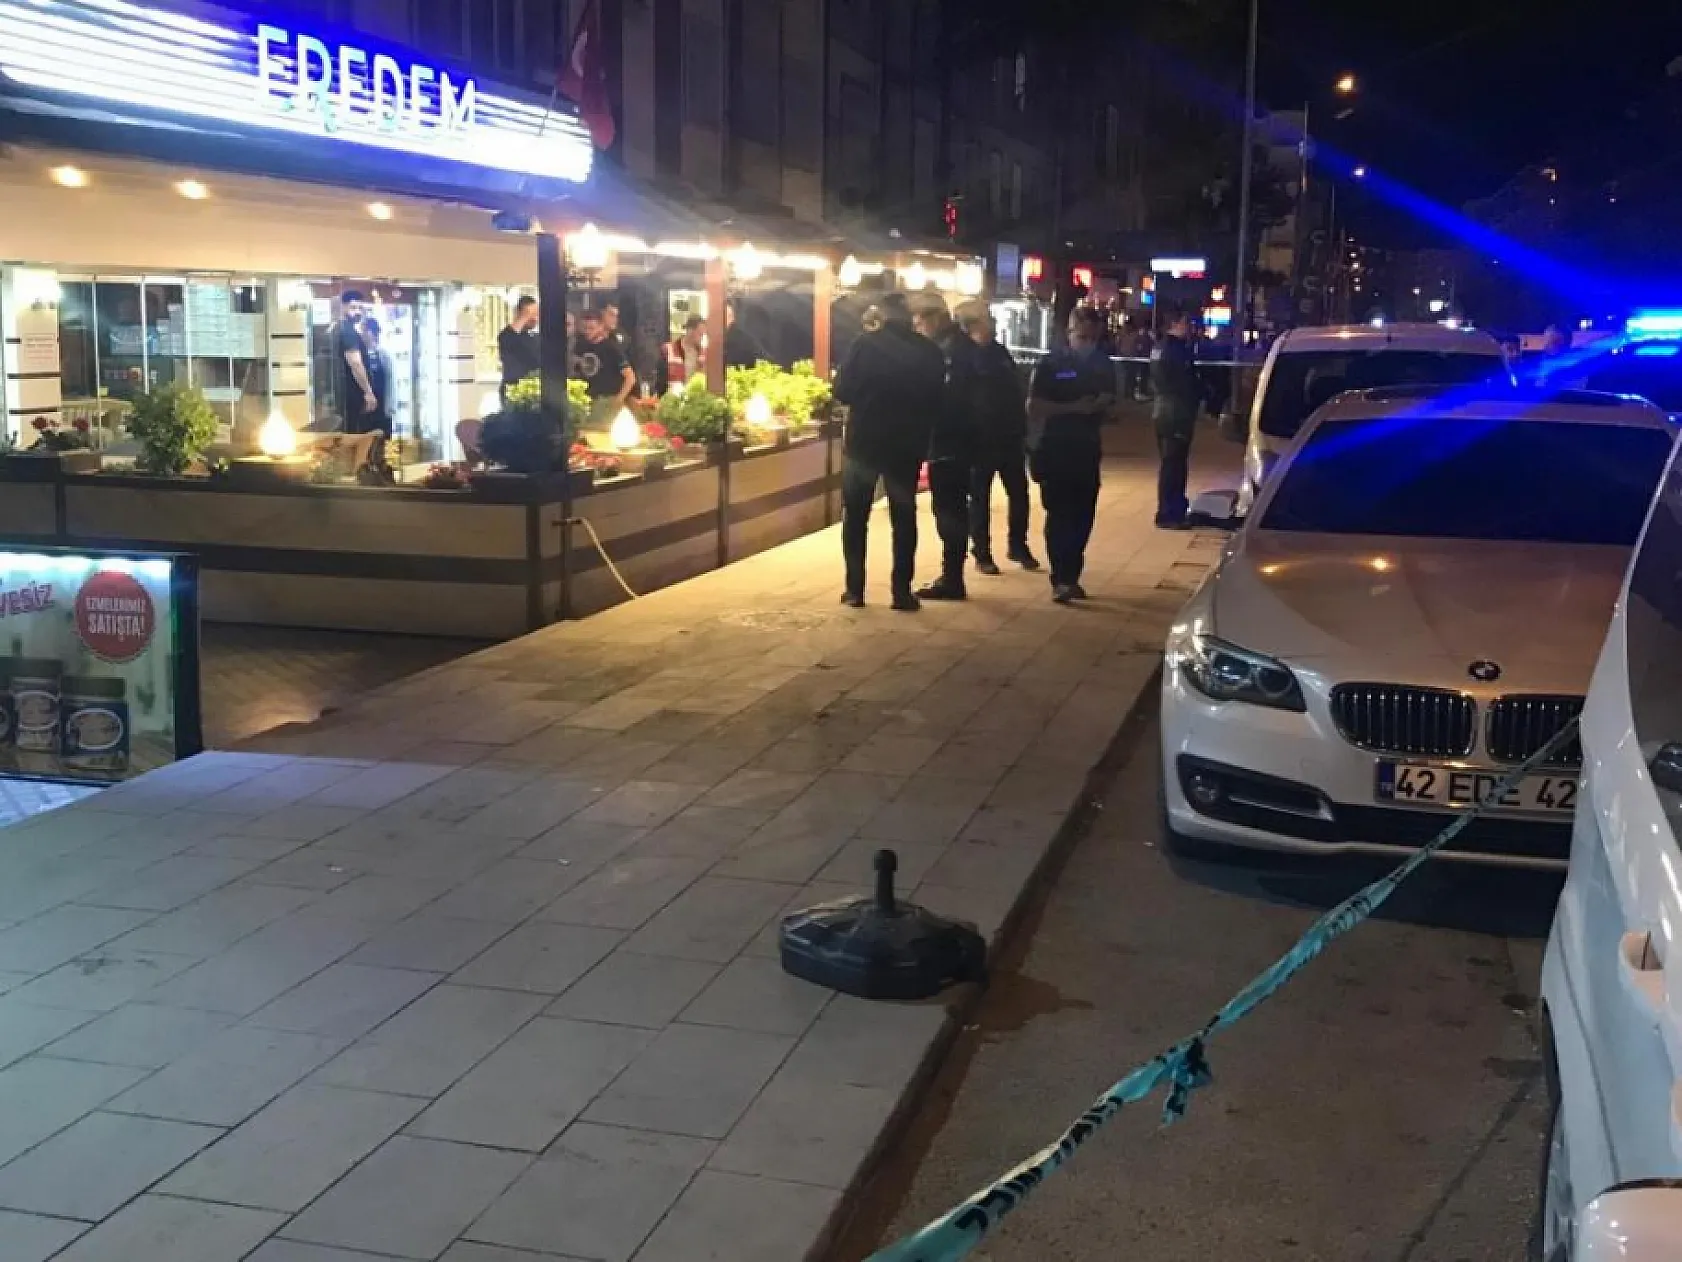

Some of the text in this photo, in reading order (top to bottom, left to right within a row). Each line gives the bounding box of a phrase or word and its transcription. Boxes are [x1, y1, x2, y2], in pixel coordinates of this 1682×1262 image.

[257, 23, 476, 132] EREDEM
[1396, 768, 1436, 799] 42
[1536, 779, 1578, 809] 42
